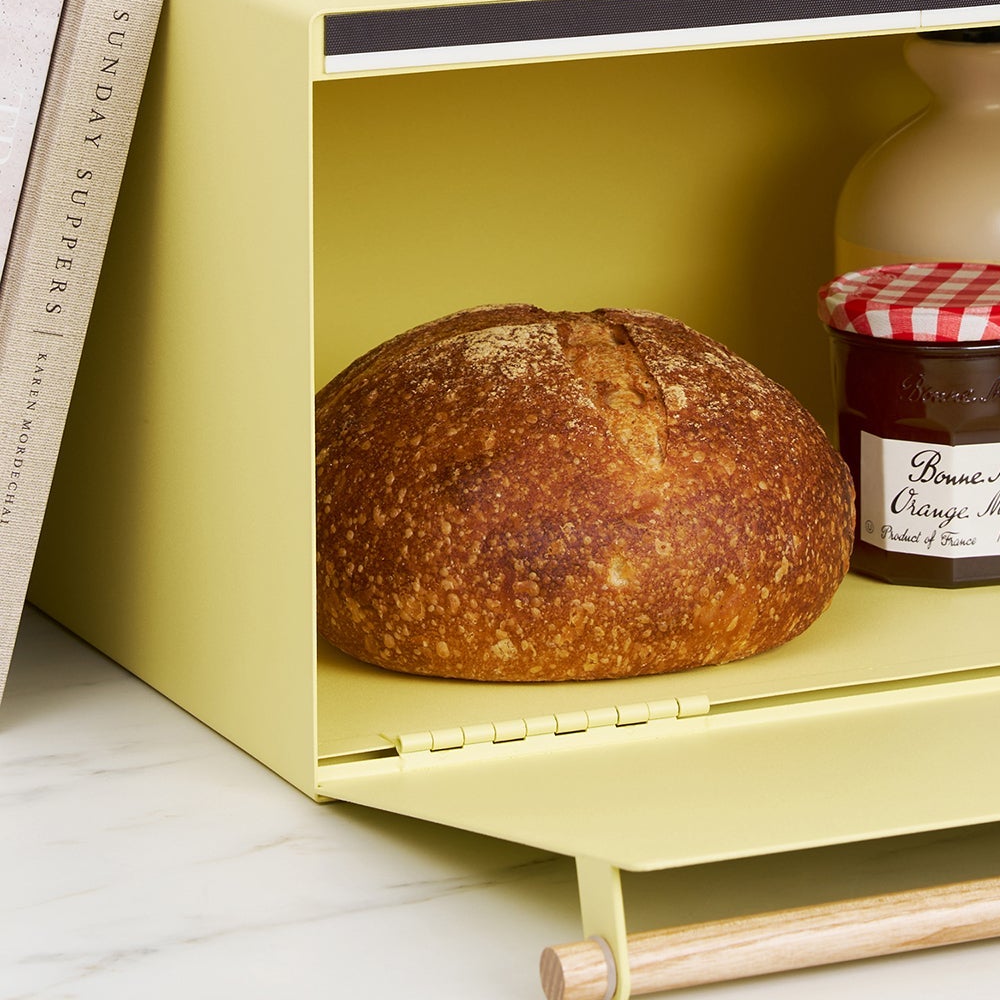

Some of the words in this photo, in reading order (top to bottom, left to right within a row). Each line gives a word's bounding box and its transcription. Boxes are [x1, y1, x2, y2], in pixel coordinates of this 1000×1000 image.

[84, 10, 130, 149] SUNDAY
[45, 169, 93, 315] SUPPERS
[25, 352, 48, 412] KAREN
[0, 418, 33, 525] MORDECHAI
[908, 449, 985, 485] Bonne
[880, 524, 926, 543] Product
[924, 533, 936, 550] of
[940, 531, 977, 547] France
[890, 486, 969, 528] Orange
